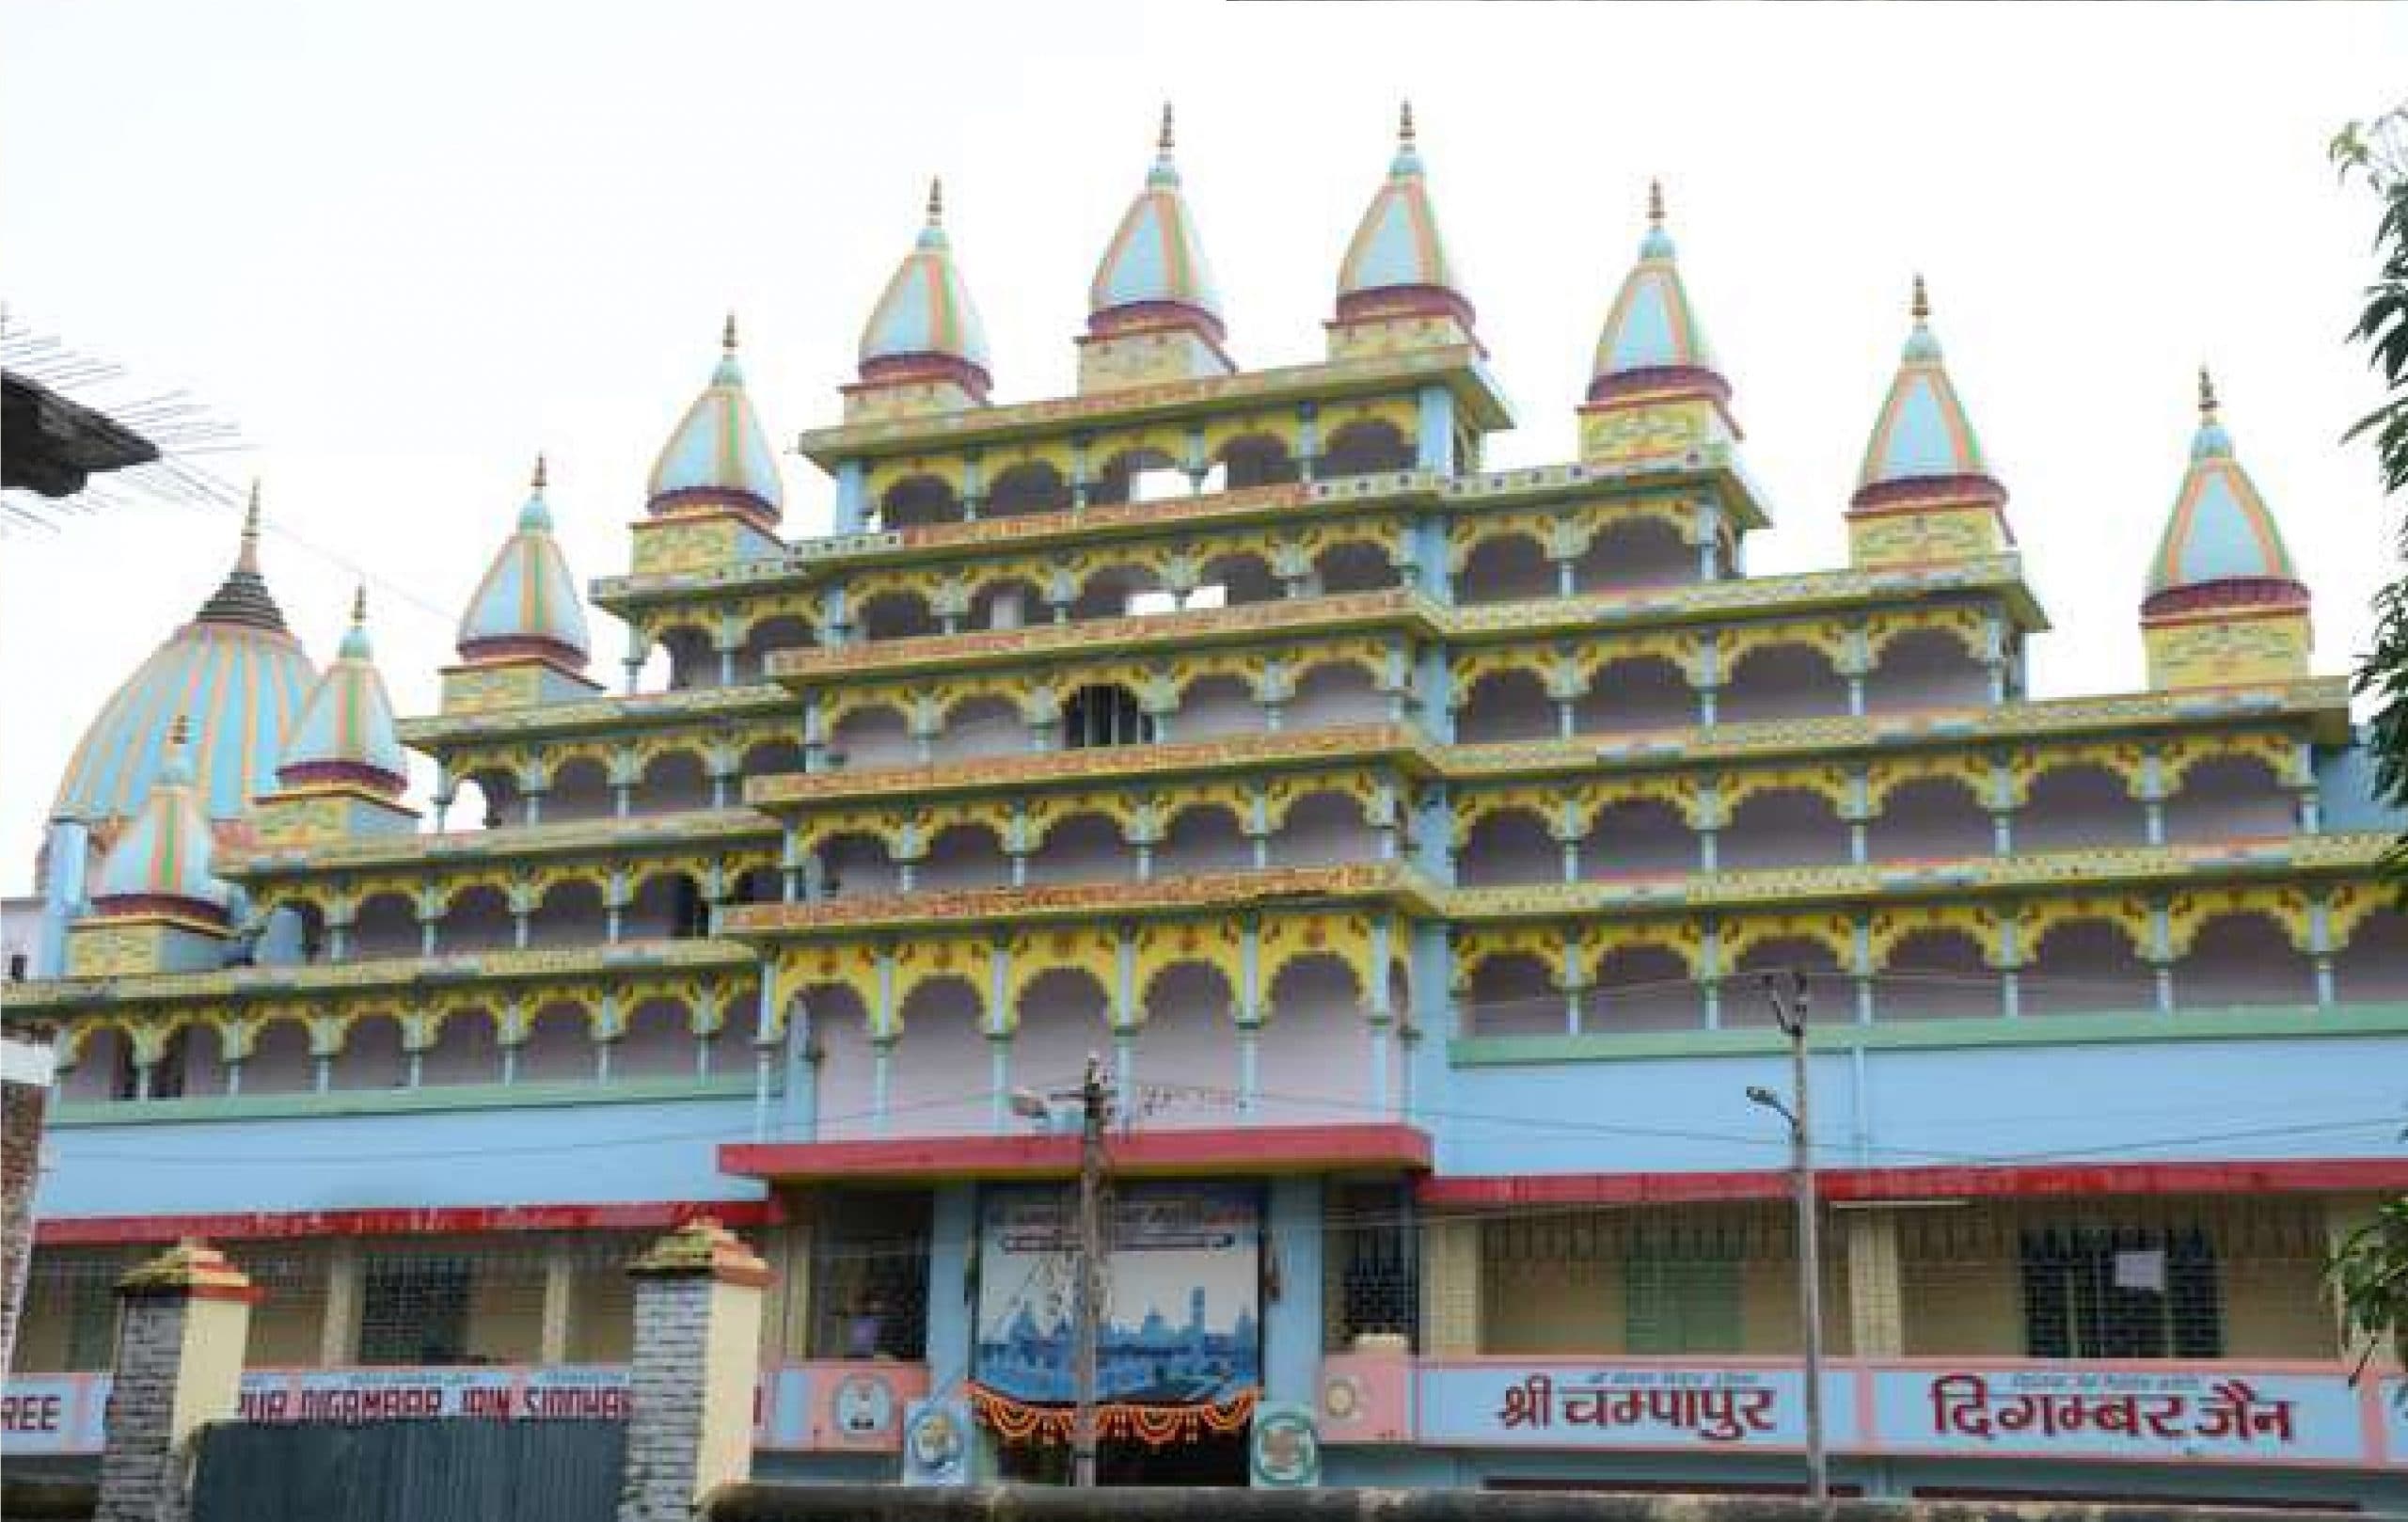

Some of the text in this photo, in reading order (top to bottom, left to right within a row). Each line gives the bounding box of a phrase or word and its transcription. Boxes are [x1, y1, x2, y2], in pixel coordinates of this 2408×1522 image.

[1499, 1373, 1552, 1430] श्री
[1931, 1373, 2295, 1441] दिगम्बर जैन
